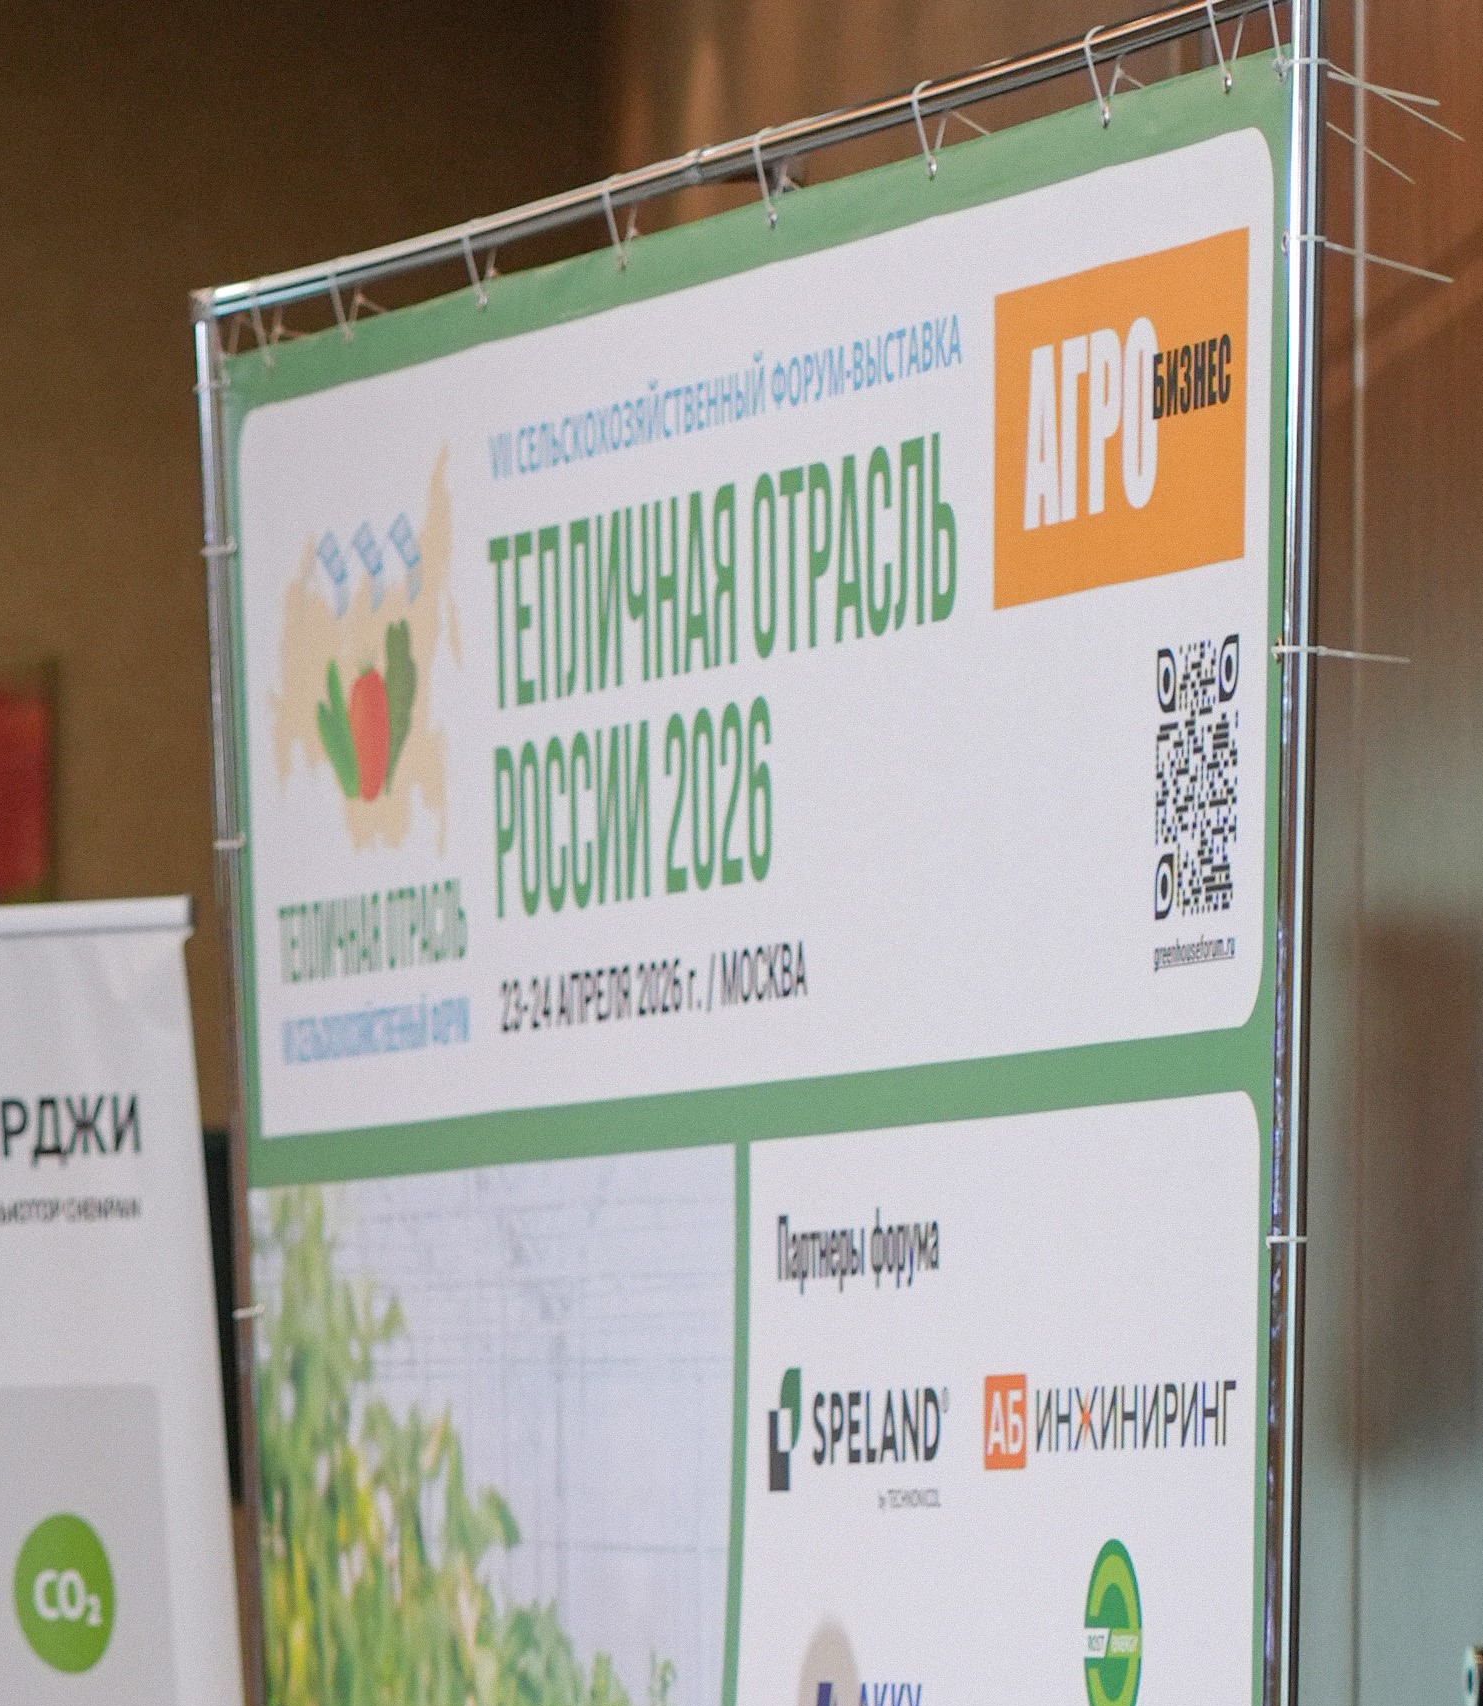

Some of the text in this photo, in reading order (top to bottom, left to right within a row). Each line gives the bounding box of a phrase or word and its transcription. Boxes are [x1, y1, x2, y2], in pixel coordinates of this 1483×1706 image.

[516, 352, 767, 475] СЕЛЬСКОХОЗЯЙСТВЕННЫЙ
[770, 314, 962, 408] ФОРУМ-ВЫСТАВКА
[1024, 316, 1232, 531] АГРО БИЗНЕС
[488, 432, 958, 710] ТЕПЛИЧНАЯ ОТРАСЛЬ
[495, 695, 772, 918] РОССИИ 2026
[501, 972, 554, 1033] 23-24
[557, 964, 631, 1026] АПРЕЛЯ
[635, 959, 682, 1016] 2026
[719, 940, 808, 1006] МОСКВА
[778, 1208, 940, 1294] Партнеры форума
[987, 1380, 1236, 1455] АБ ИНЖИНИРИНГ
